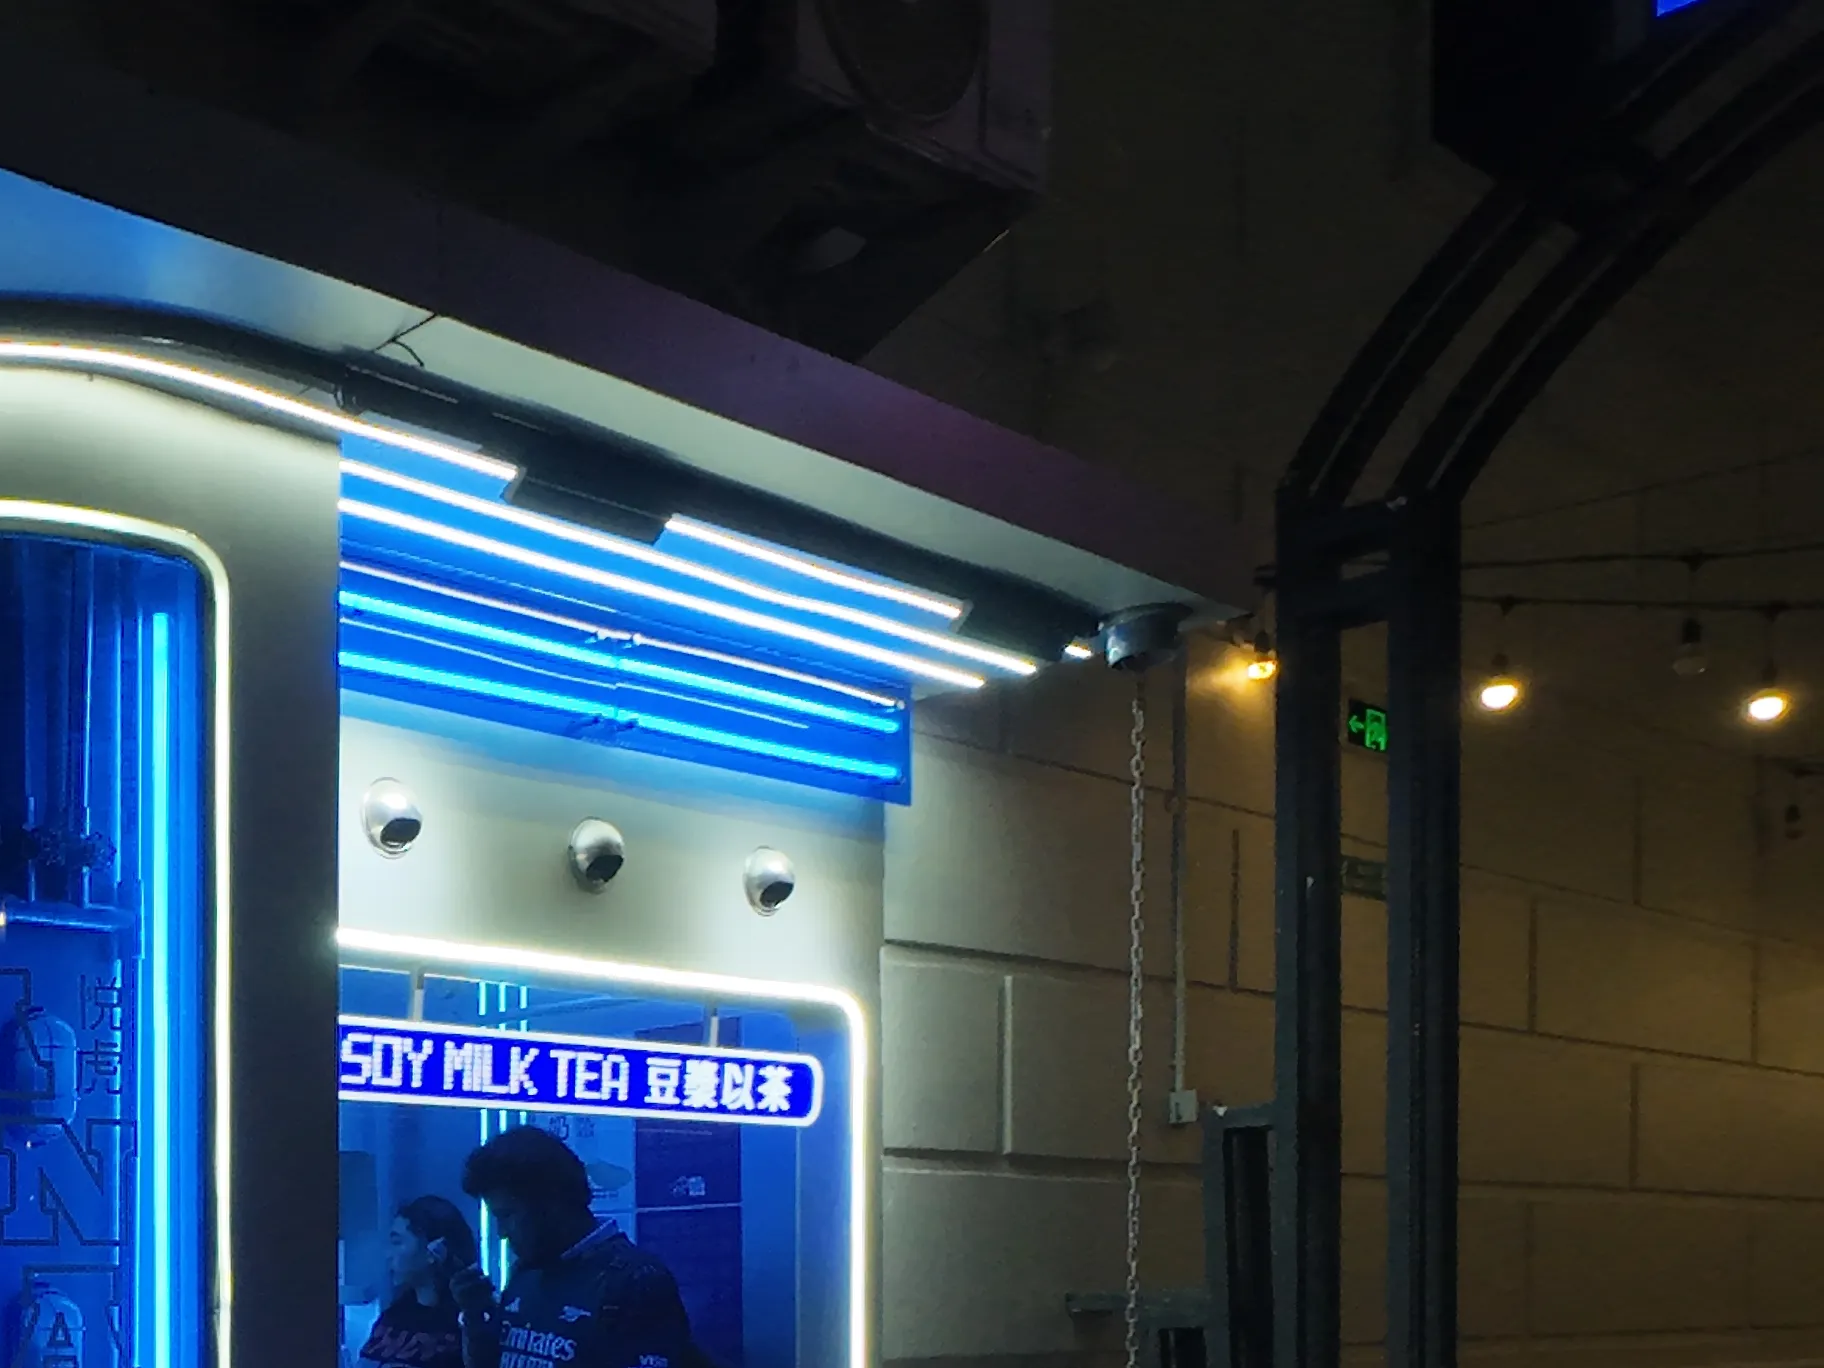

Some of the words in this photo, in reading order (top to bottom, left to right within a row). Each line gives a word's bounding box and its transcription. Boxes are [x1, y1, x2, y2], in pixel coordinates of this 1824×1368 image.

[340, 1032, 434, 1089] SOY
[443, 1040, 539, 1097] MILK
[549, 1048, 630, 1102] TEA
